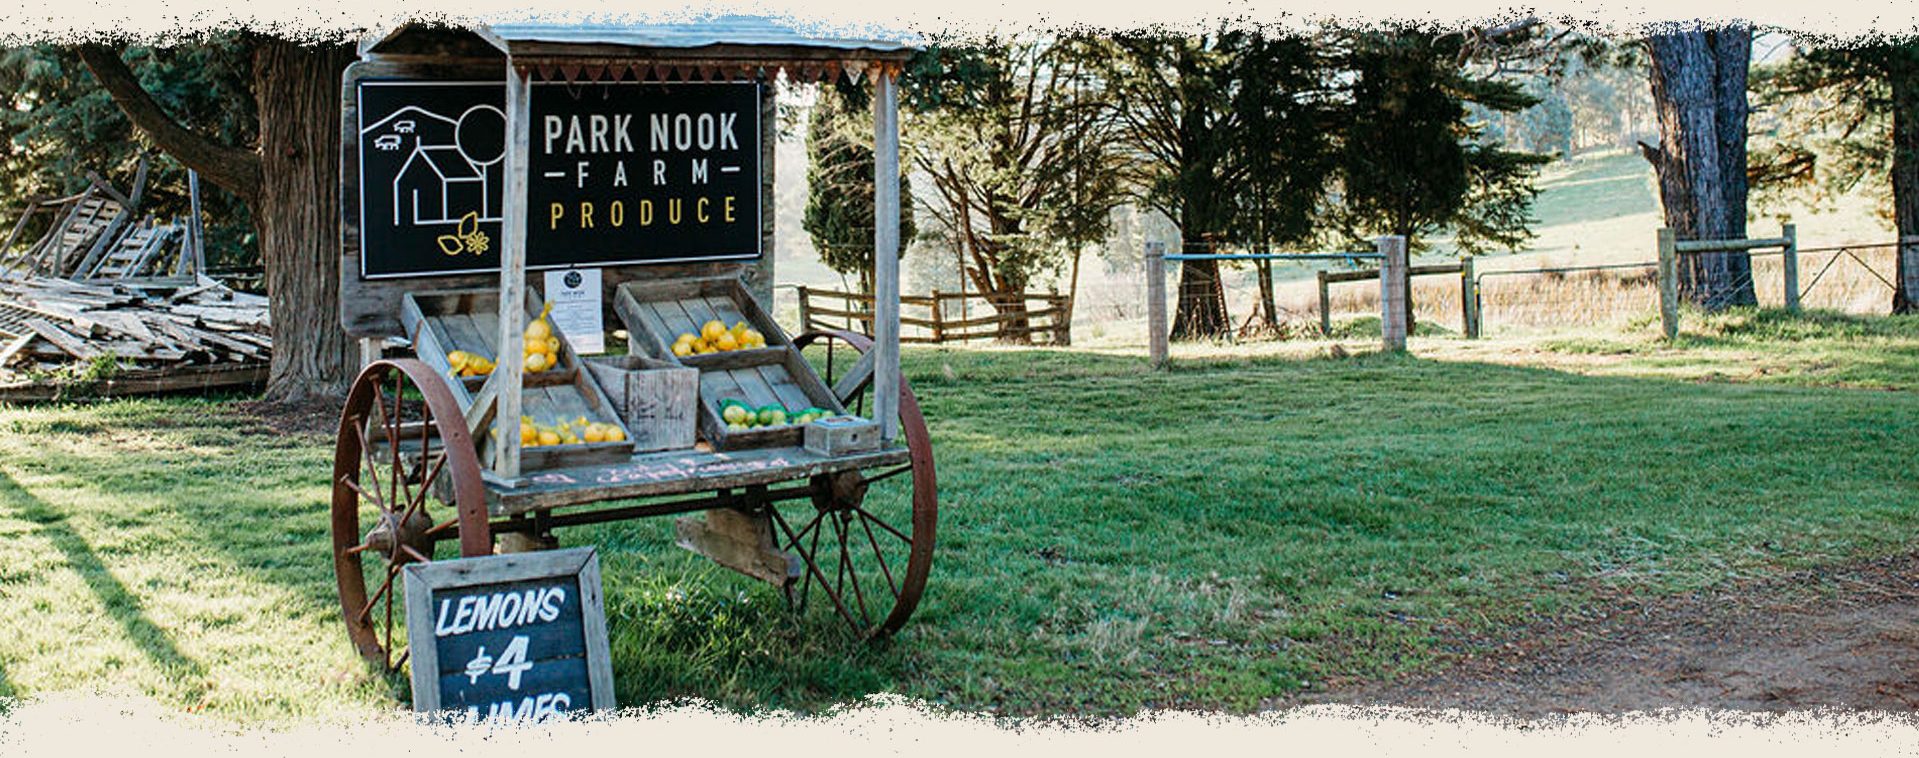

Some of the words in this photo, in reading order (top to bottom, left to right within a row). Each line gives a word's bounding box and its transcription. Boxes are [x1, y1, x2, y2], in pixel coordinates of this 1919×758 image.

[543, 114, 635, 154] PARK
[650, 112, 739, 152] NOOK
[577, 159, 708, 188] FARM
[550, 196, 736, 230] PRODUCE
[435, 587, 566, 637] LEMONS
[464, 635, 534, 690] $4
